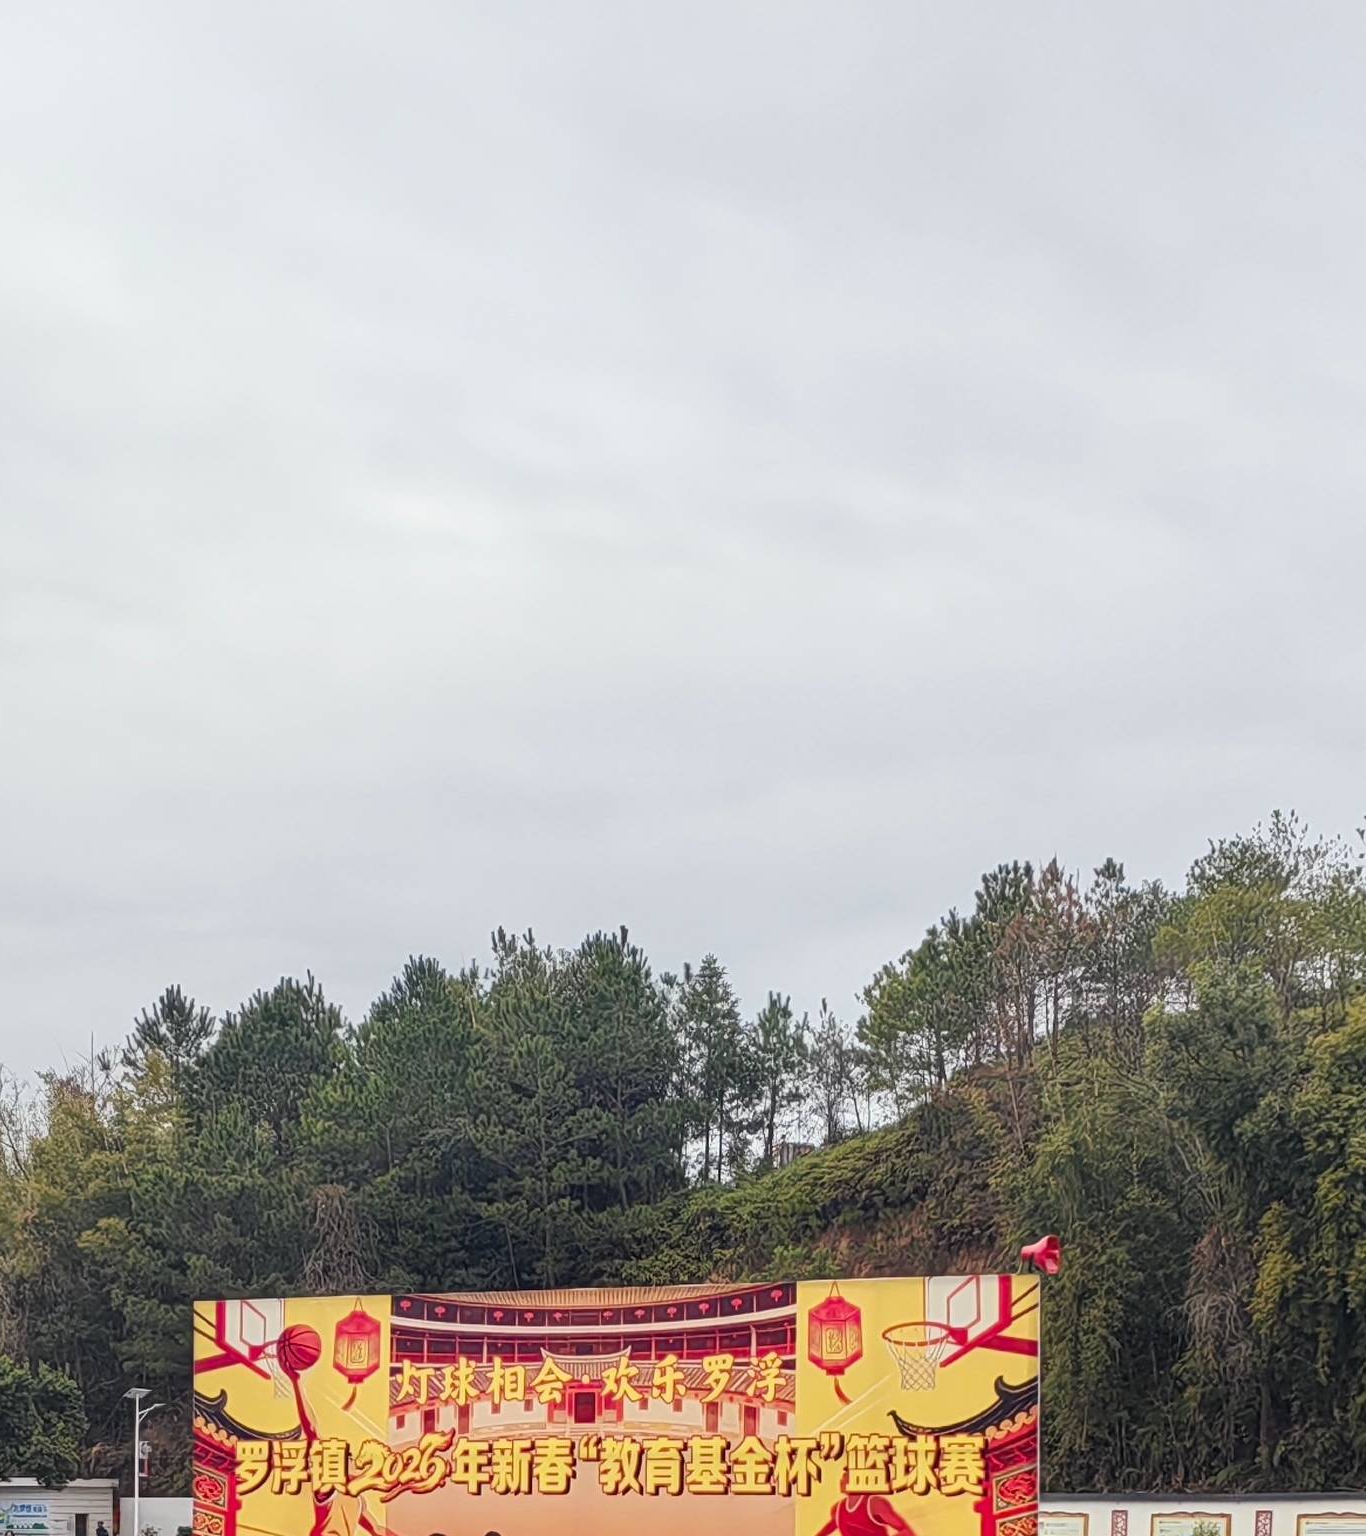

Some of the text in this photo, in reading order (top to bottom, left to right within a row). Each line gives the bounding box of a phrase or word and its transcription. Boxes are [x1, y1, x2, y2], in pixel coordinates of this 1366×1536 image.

[396, 1352, 787, 1404] 灯球相会·欢乐罗浮
